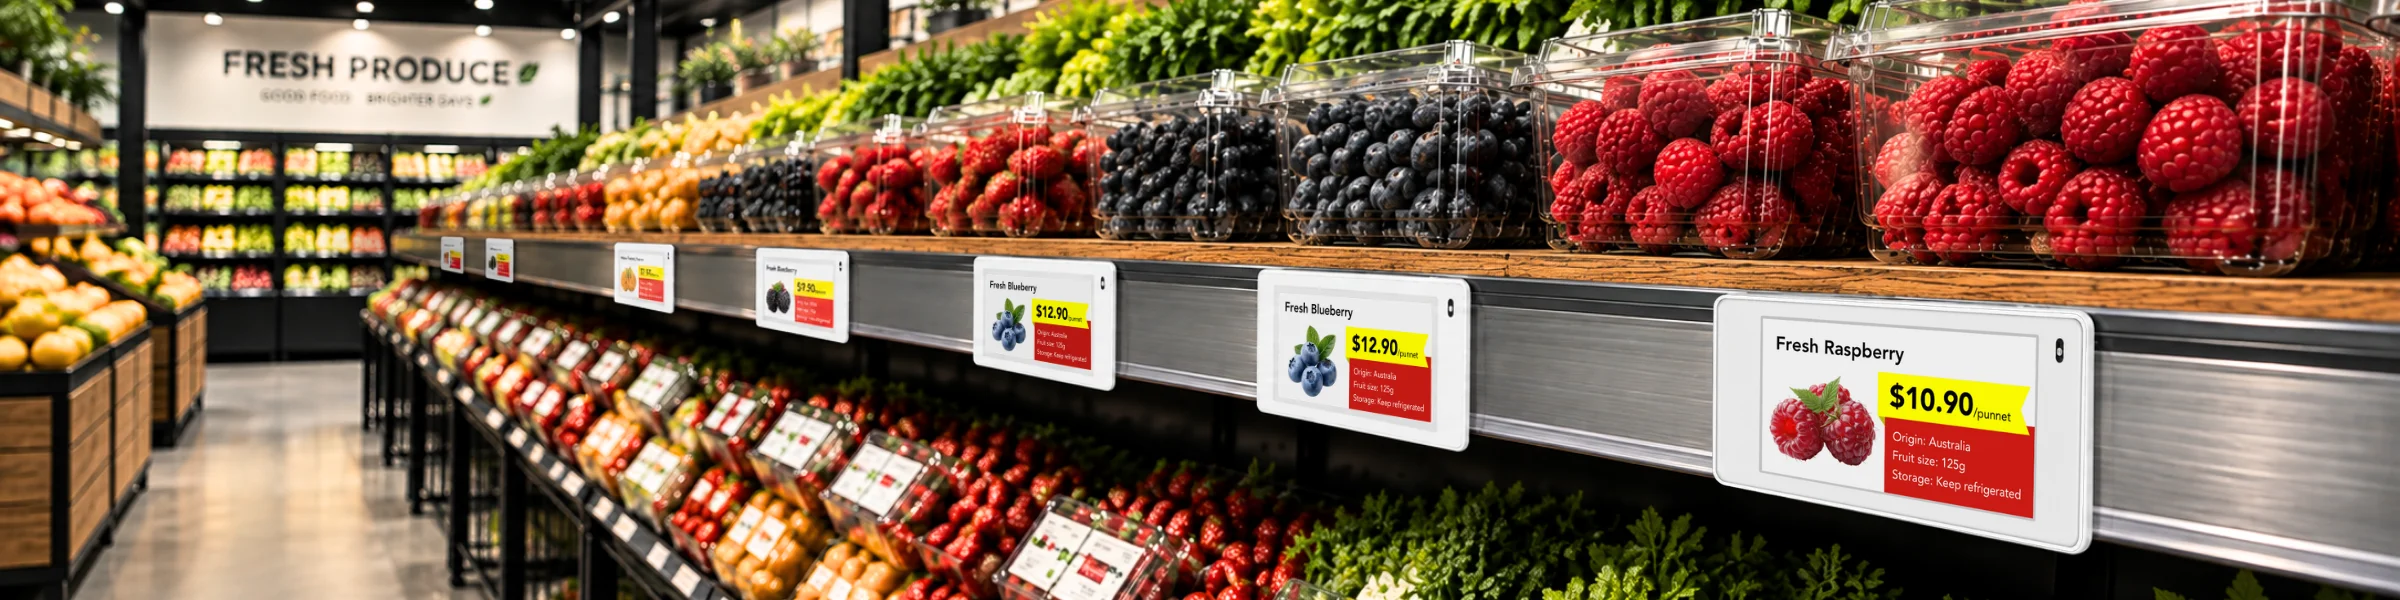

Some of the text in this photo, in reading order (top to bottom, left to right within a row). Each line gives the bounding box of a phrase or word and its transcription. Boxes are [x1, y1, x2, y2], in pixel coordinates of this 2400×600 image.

[223, 50, 510, 85] FRESH PRODUCE
[366, 93, 433, 106] BRIGHTER
[990, 280, 1037, 294] Fresh Blueberry
[1036, 304, 1068, 320] $12.90
[1285, 301, 1353, 320] Fresh Blueberry
[1352, 334, 1419, 360] $12.90 /punnet
[1776, 336, 1904, 365] Fresh Raspberry
[1353, 368, 1397, 381] Origin: Australia
[1353, 381, 1394, 395] Fruit size: 125g
[1353, 394, 1425, 413] Storage: Keep refrigerated
[1889, 382, 2011, 423] $10.90 /punnet
[1892, 431, 1971, 452] Origin: Australia
[1892, 450, 1966, 473] Fruit size: 125g
[1892, 469, 2022, 500] Storage: Keep refrigerated
